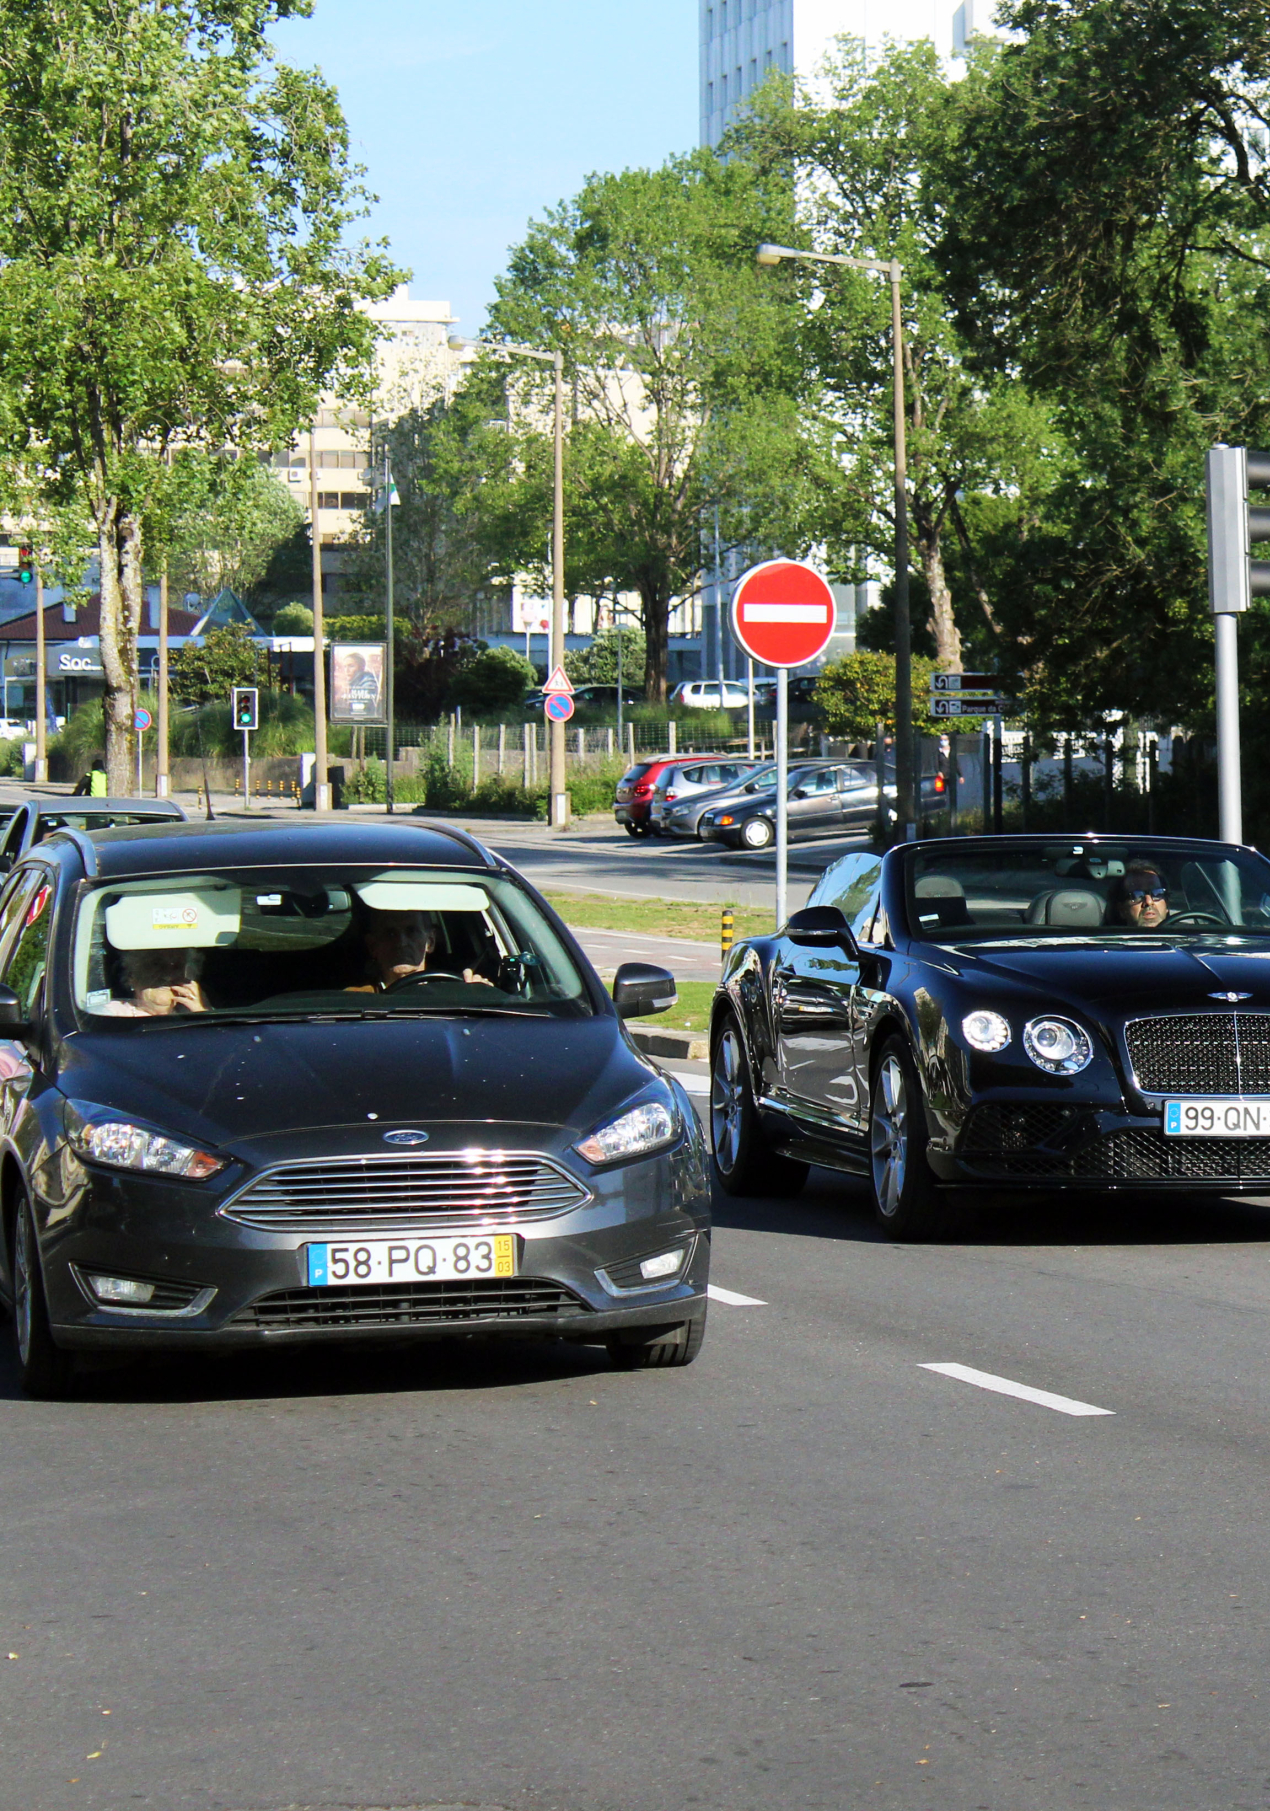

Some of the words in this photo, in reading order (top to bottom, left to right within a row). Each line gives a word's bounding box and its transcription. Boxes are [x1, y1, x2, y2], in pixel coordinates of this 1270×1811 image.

[962, 705, 986, 713] Parque
[1170, 1121, 1177, 1129] P
[497, 1240, 510, 1251] 15
[497, 1261, 510, 1273] 03
[314, 1269, 323, 1279] P
